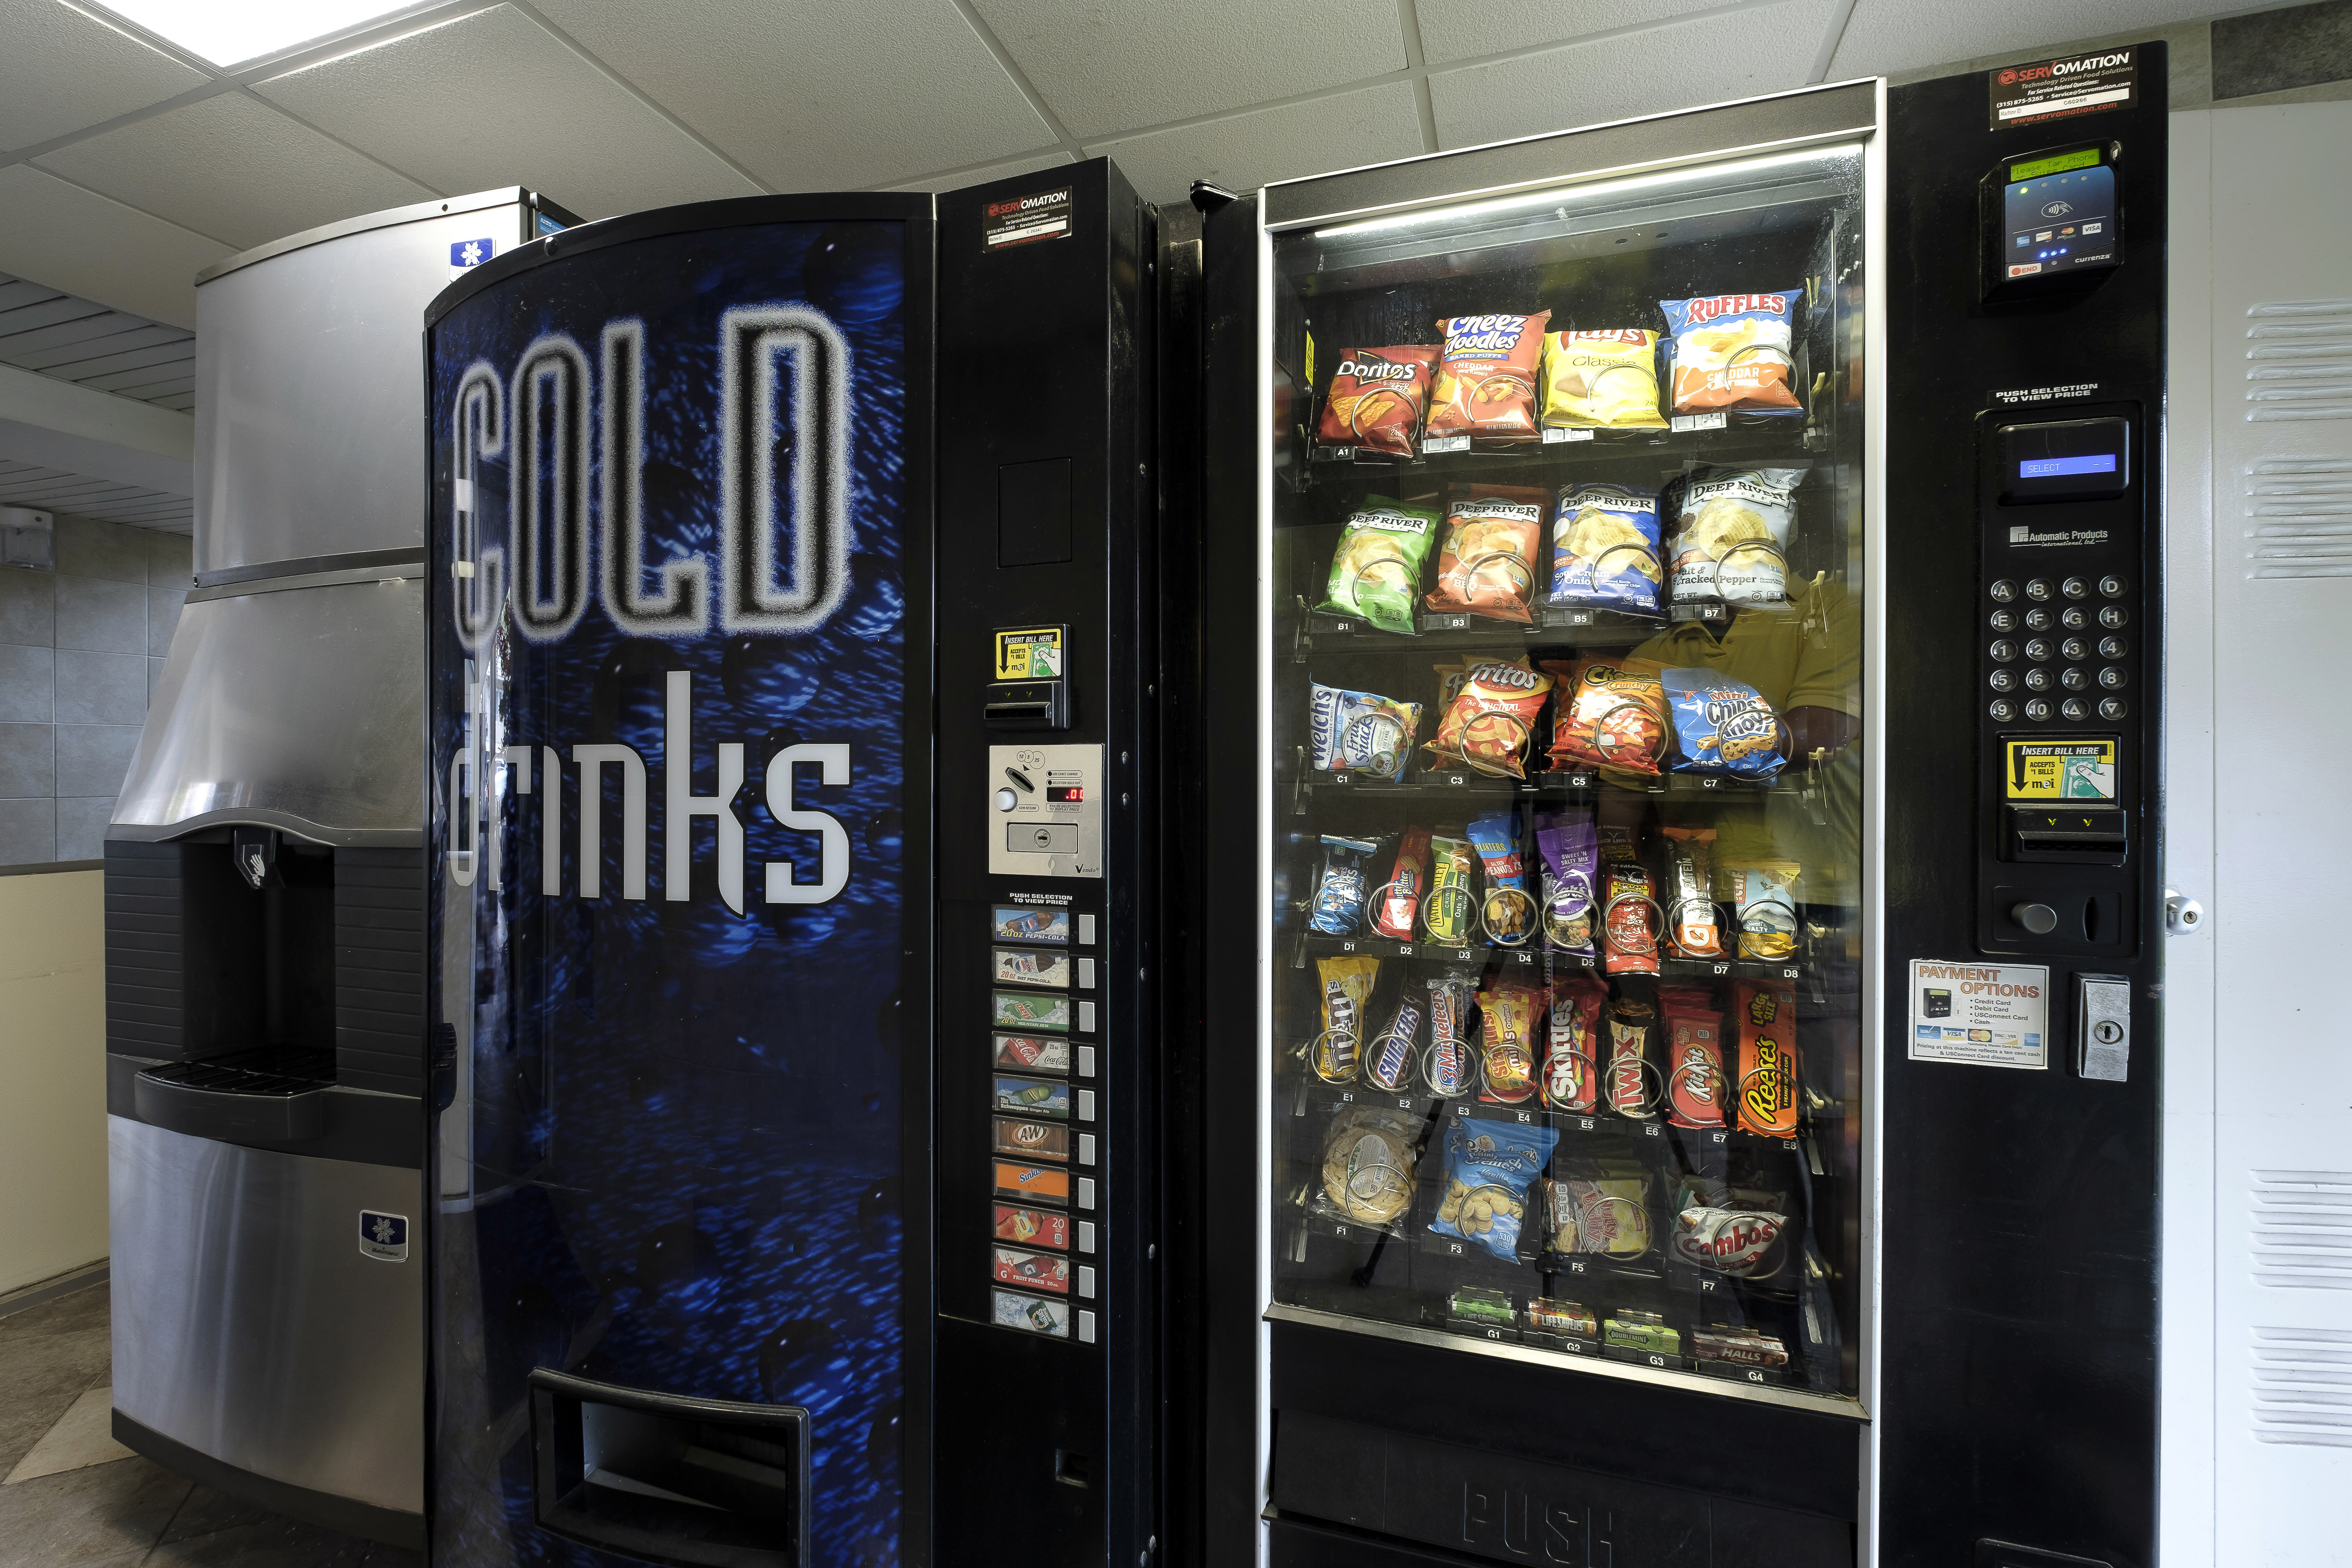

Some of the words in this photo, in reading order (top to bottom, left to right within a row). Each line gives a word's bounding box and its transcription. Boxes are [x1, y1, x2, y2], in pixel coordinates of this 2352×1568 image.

[2018, 52, 2129, 81] SERVOMATION
[2022, 79, 2059, 89] Technology
[2060, 74, 2082, 83] Driven
[2101, 65, 2133, 76] Solutions
[2011, 102, 2117, 125] www.servomation.com
[2047, 160, 2062, 169] Tap
[2068, 153, 2096, 163] Phone
[1000, 191, 1067, 214] SERVOMATION
[1050, 202, 1069, 210] Solutions
[995, 231, 1059, 249] www.servomation.com
[2075, 254, 2110, 263] currenza
[1686, 294, 1785, 324] RUFFLES
[1445, 331, 1520, 356] doodles
[1336, 360, 1417, 379] Doritos
[1453, 362, 1495, 372] CHEDDAR
[2031, 383, 2098, 394] SELECTION
[2055, 390, 2091, 398] PRICE
[2027, 463, 2061, 474] SELECT
[454, 306, 853, 650] COLD
[1693, 482, 1734, 498] DEEP
[1736, 481, 1786, 501] RIVER
[1566, 494, 1601, 507] DEEP
[1602, 496, 1652, 509] RIVER
[1454, 503, 1490, 514] DEEP
[1491, 505, 1537, 518] RIVER
[1382, 516, 1424, 530] RIVER
[2029, 531, 2069, 542] Automatic
[2071, 530, 2108, 539] Products
[1719, 575, 1757, 585] Pepper
[1998, 586, 2009, 596] A
[2034, 584, 2044, 595] B
[2069, 583, 2081, 593] C
[2107, 581, 2118, 592] D
[1998, 615, 2008, 626] E
[2034, 614, 2043, 625] F
[2069, 613, 2082, 624] G
[2106, 611, 2118, 622] H
[1004, 635, 1025, 644] INSERT
[2000, 645, 2006, 656] 1
[2034, 644, 2043, 655] 2
[2070, 643, 2080, 654] 3
[2107, 642, 2116, 653] 4
[1011, 662, 1025, 671] mei
[1469, 662, 1538, 690] Fritos
[1998, 675, 2007, 686] 5
[2034, 674, 2043, 685] 6
[2070, 673, 2080, 684] 7
[2107, 672, 2116, 684] 8
[1607, 681, 1651, 691] Crunchy
[1709, 691, 1748, 701] Mini
[1998, 704, 2007, 715] 9
[2031, 704, 2047, 715] 10
[1311, 690, 1332, 761] Welch's
[2021, 746, 2053, 755] INSERT
[1381, 758, 1391, 774] REAL
[2032, 778, 2055, 789] mei
[450, 671, 850, 916] drinks
[1475, 842, 1506, 852] PLANTERS
[1485, 864, 1514, 876] PEANUTS
[1731, 871, 1744, 897] CLIF
[1784, 969, 1798, 978] D8
[1919, 965, 2001, 982] PAYMENT
[1960, 982, 2040, 999] OPTIONS
[1751, 992, 1770, 1025] LARGE
[1378, 1005, 1421, 1087] SNICKERS
[1550, 999, 1576, 1100] Skittles
[1610, 1034, 1644, 1110] Twix
[1747, 1035, 1777, 1123] Reese's
[1000, 1103, 1029, 1111] Schweppes
[1019, 1125, 1042, 1143] A&W
[1459, 1107, 1469, 1115] E3
[1519, 1113, 1530, 1122] E4
[1582, 1120, 1593, 1129] E5
[1646, 1127, 1658, 1136] E6
[1713, 1134, 1726, 1142] E7
[1784, 1141, 1796, 1149] E8
[1481, 1167, 1509, 1181] Vanilla
[1052, 1217, 1065, 1229] 20
[1498, 1232, 1511, 1243] 530
[1682, 1222, 1776, 1257] combos
[1451, 1245, 1461, 1253] F3
[1572, 1263, 1583, 1272] F5
[1703, 1281, 1715, 1290] F7
[1611, 1330, 1647, 1344] DOUBLEMINT
[1488, 1330, 1499, 1338] G1
[1567, 1343, 1580, 1352] G2
[1650, 1356, 1663, 1365] G3
[1749, 1372, 1763, 1381] G4
[1722, 1347, 1761, 1362] HALLS
